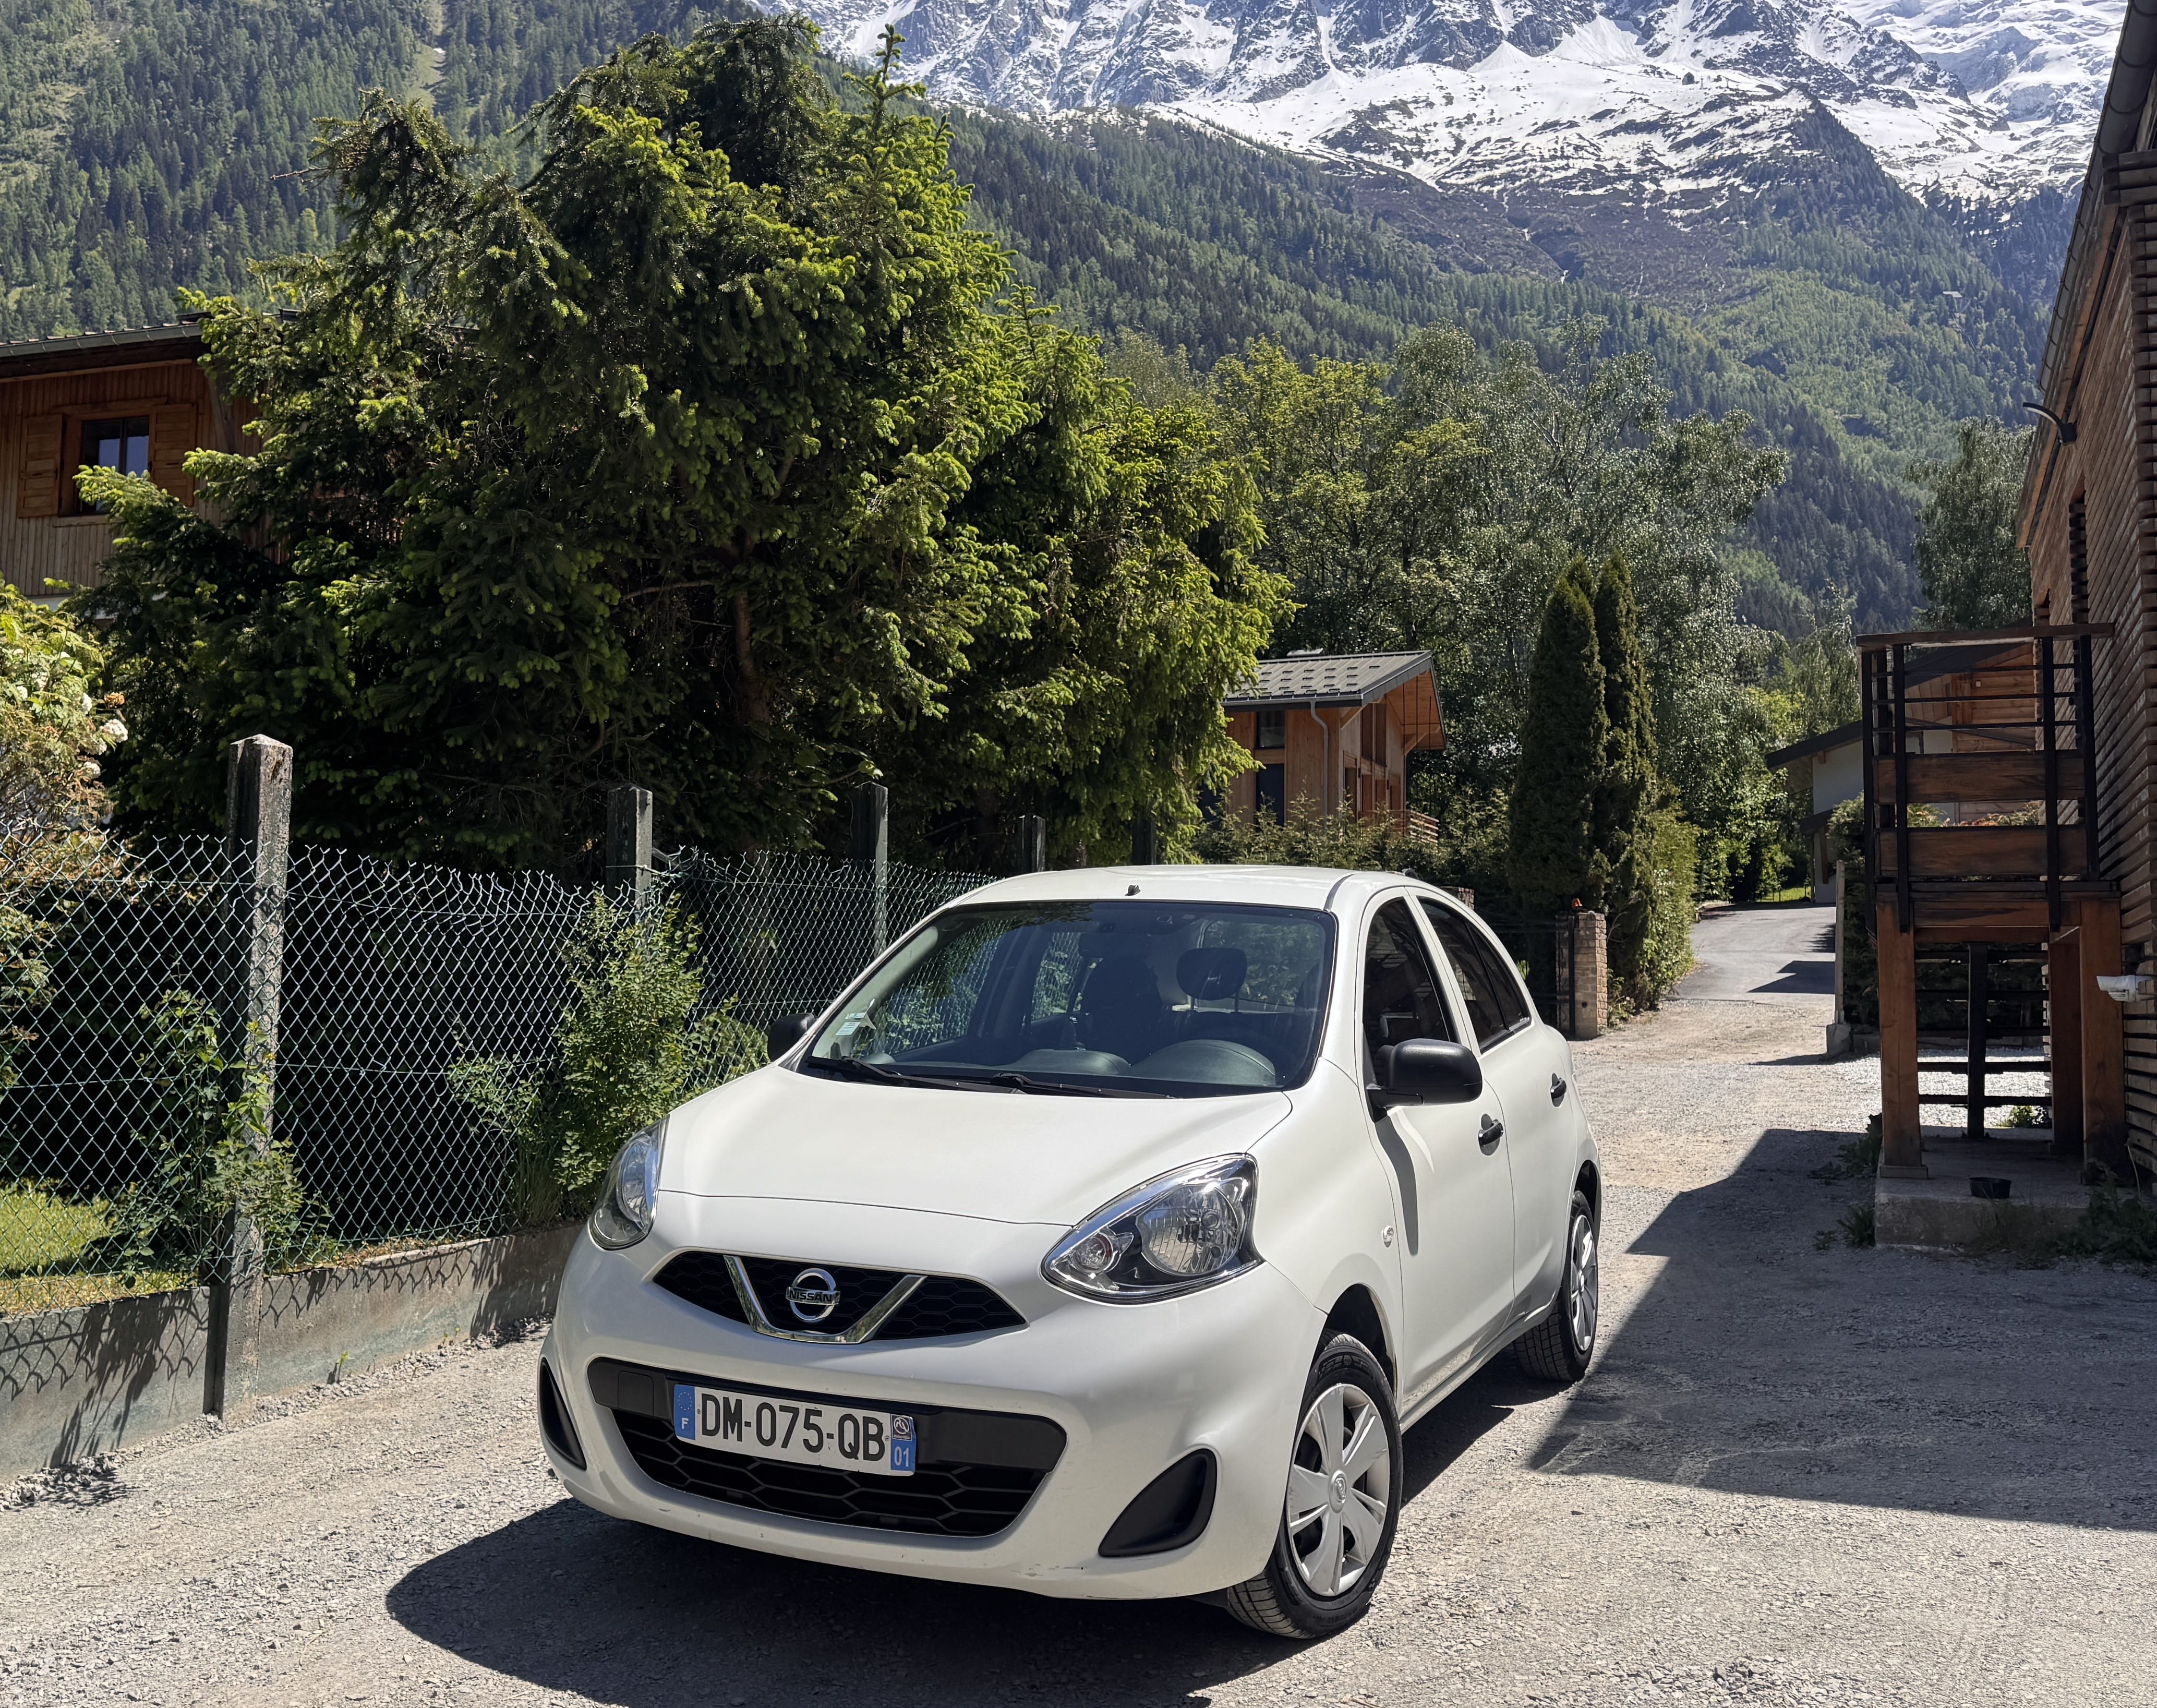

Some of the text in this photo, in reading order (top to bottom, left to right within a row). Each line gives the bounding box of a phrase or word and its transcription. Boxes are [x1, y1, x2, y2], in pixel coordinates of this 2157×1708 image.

[789, 1291, 832, 1302] NISSAN
[681, 1417, 689, 1429] F
[701, 1393, 885, 1461] DM-075-QB
[895, 1446, 909, 1467] 01
